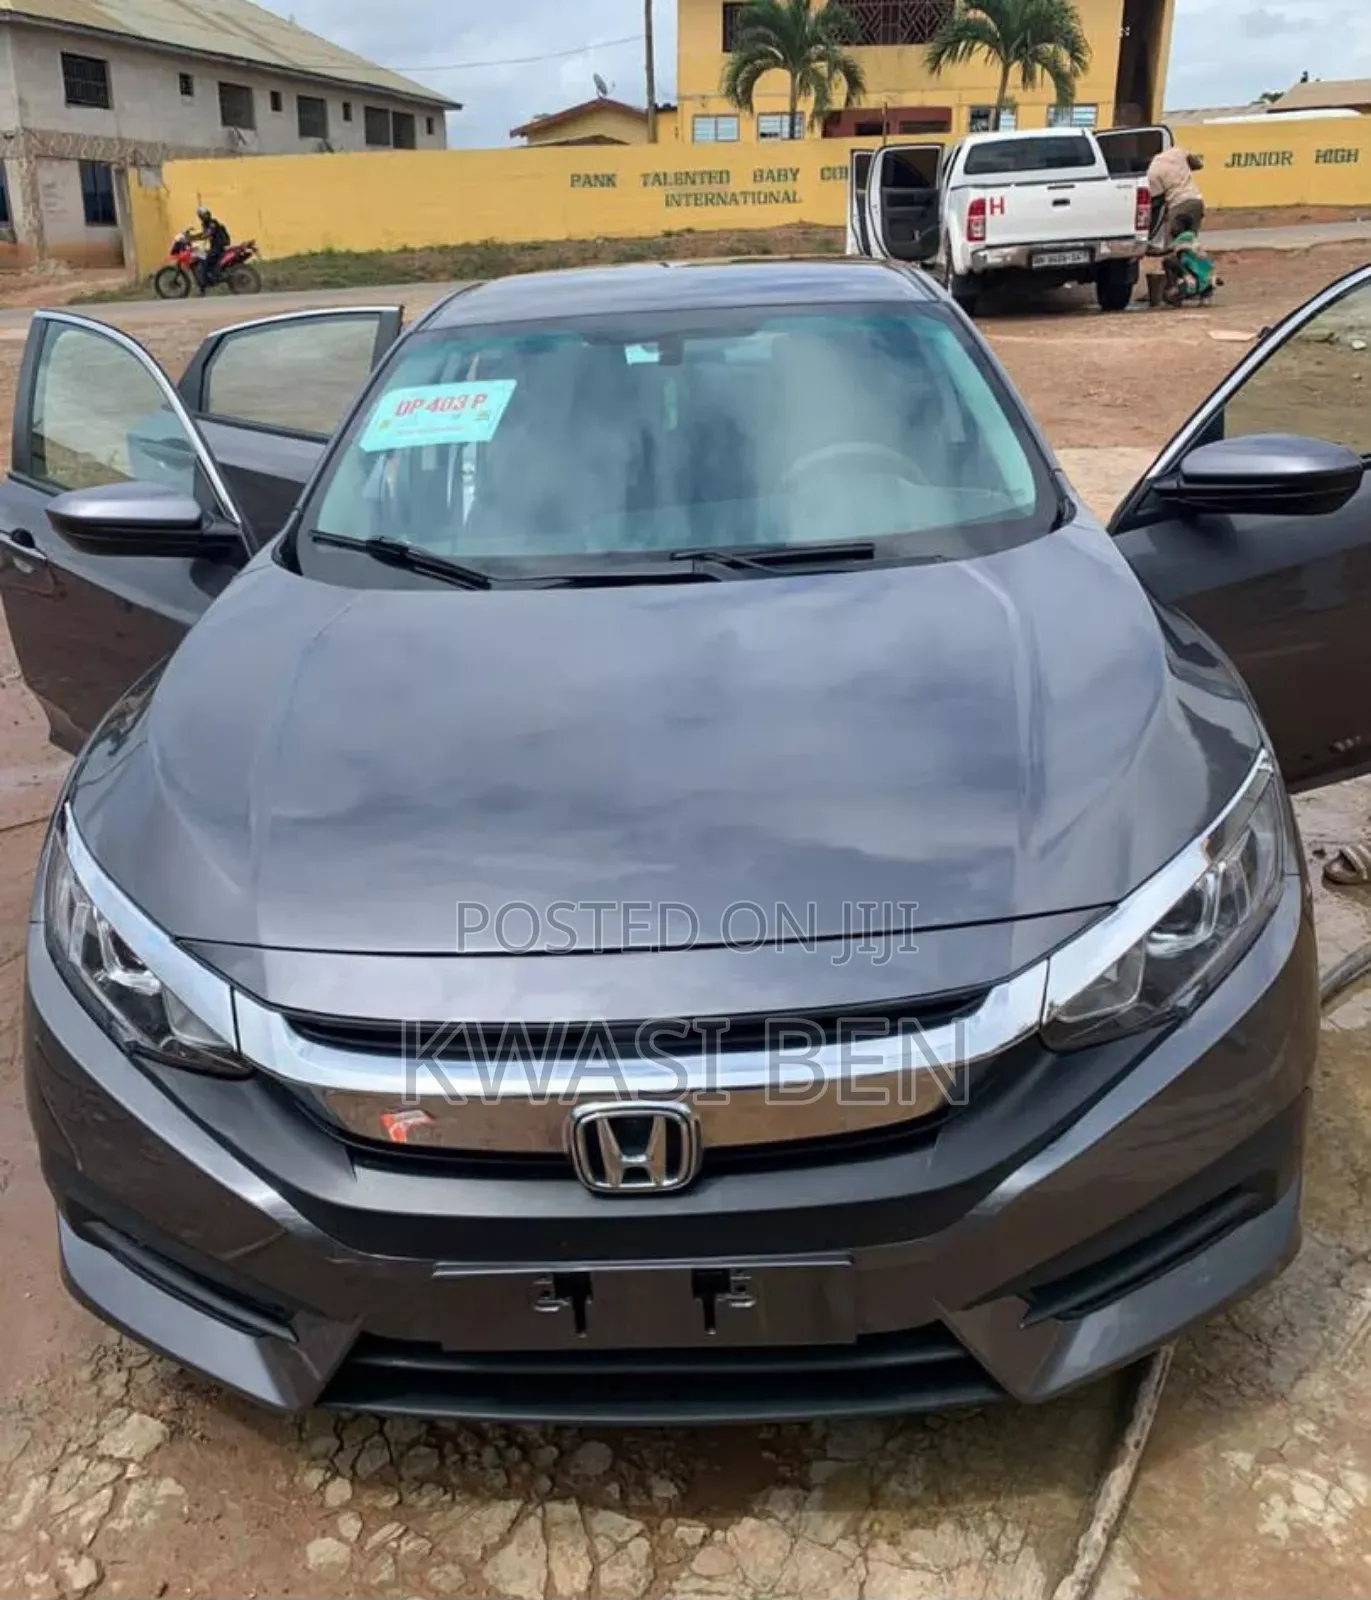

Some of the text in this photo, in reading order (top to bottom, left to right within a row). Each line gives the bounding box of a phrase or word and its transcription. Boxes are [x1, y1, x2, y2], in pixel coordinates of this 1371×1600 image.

[1225, 148, 1360, 168] JUNIOR HIGH
[640, 169, 730, 187] TALENTED
[753, 167, 800, 184] BABY
[665, 190, 802, 208] INTERNATIONAL
[989, 196, 1004, 215] H
[471, 393, 488, 409] P
